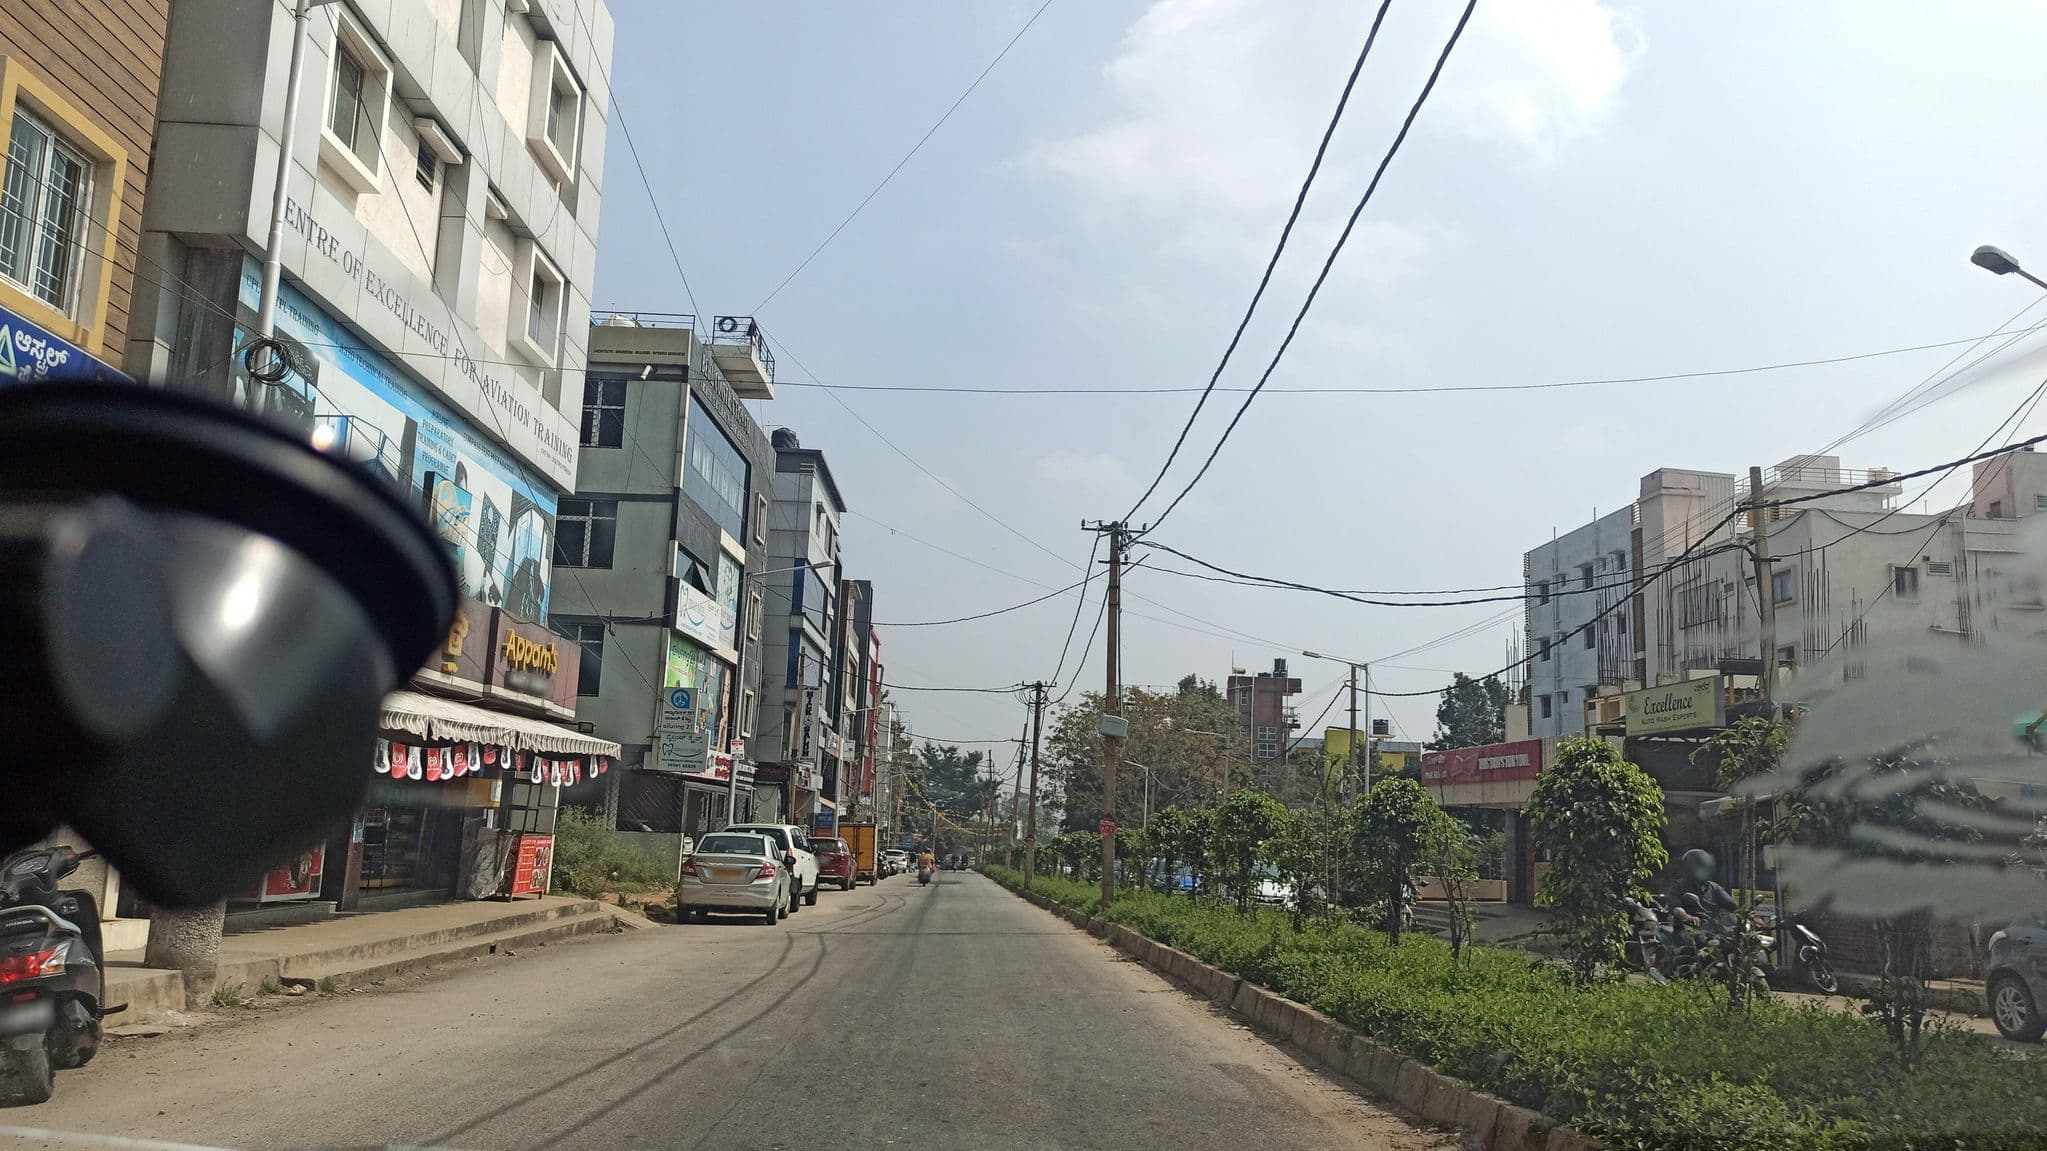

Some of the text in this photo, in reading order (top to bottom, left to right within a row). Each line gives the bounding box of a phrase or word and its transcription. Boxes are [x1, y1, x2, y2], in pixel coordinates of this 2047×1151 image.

[285, 195, 340, 264] ENTRE
[343, 250, 362, 280] OF
[365, 269, 448, 356] EXCELLENCE
[453, 347, 477, 383] FOR
[482, 374, 531, 428] AVIATION
[533, 417, 573, 463] TRAINING
[503, 627, 559, 674] Appam's
[1644, 692, 1693, 715] Excellence
[1672, 711, 1697, 721] EXPERTS
